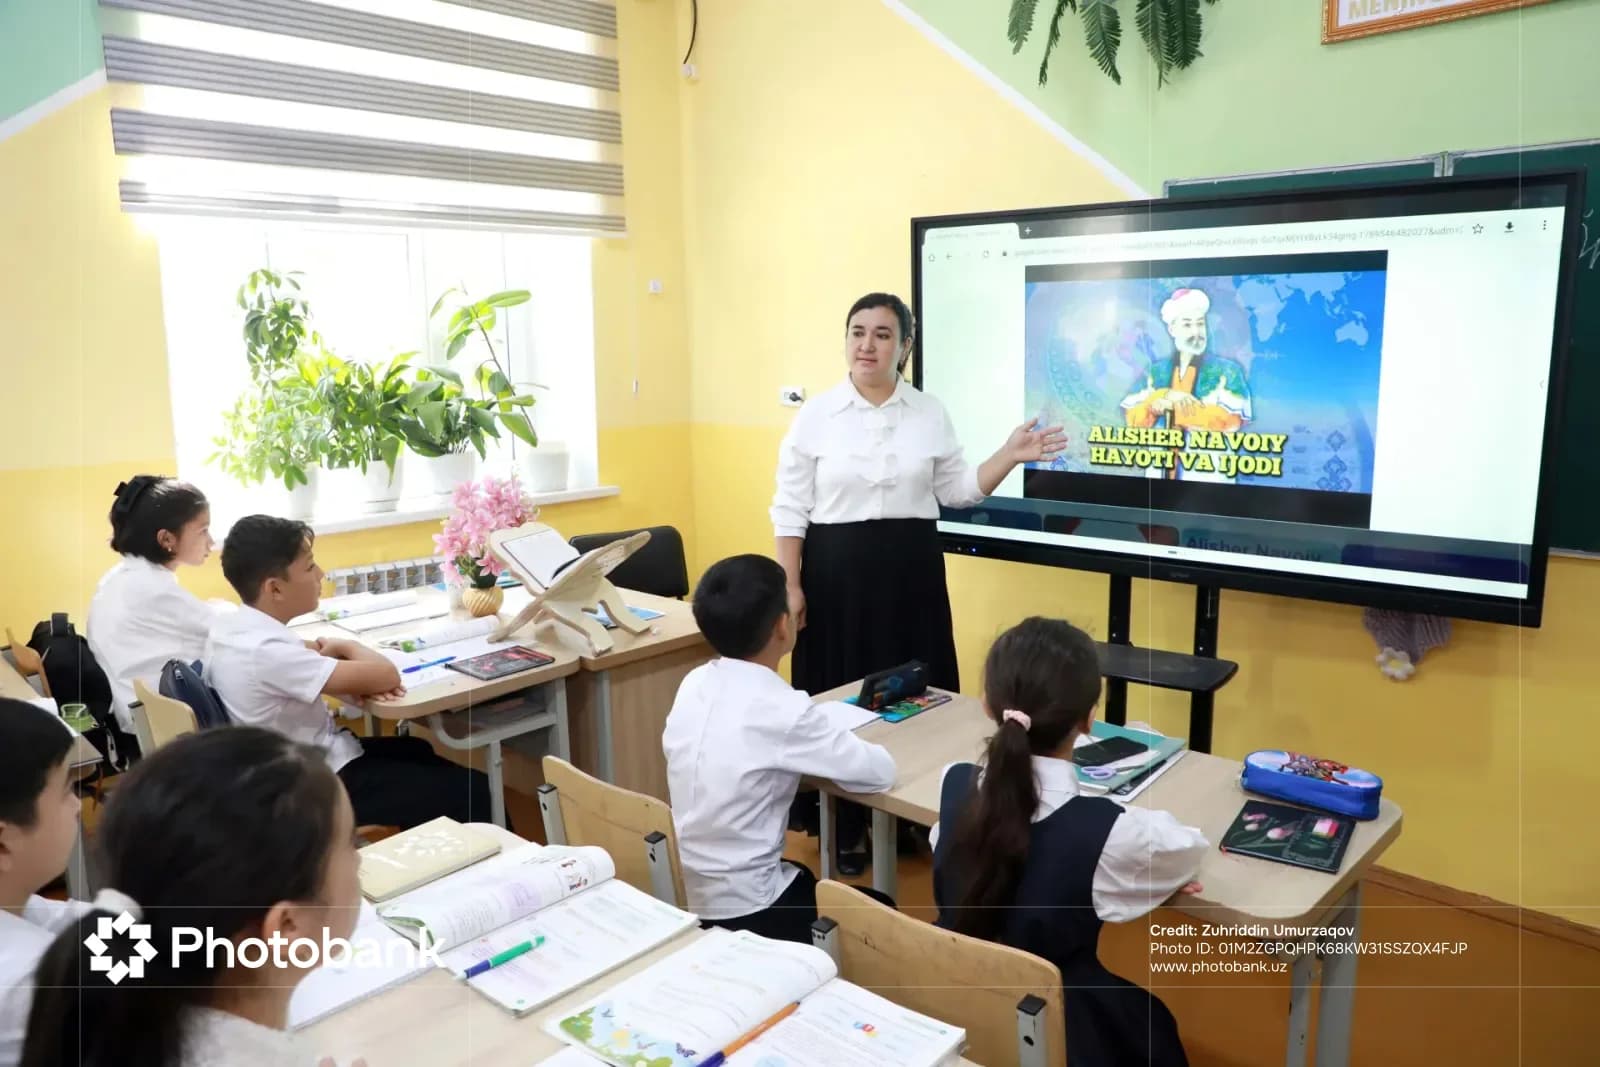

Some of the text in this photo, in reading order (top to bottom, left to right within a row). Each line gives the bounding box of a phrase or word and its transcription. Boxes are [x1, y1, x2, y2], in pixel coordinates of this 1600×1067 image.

[1089, 426, 1185, 447] ALISHER
[1190, 431, 1288, 452] NAVOIY
[1090, 447, 1174, 468] HAYOTI
[1179, 452, 1213, 472] VA
[1219, 456, 1283, 477] IJODI
